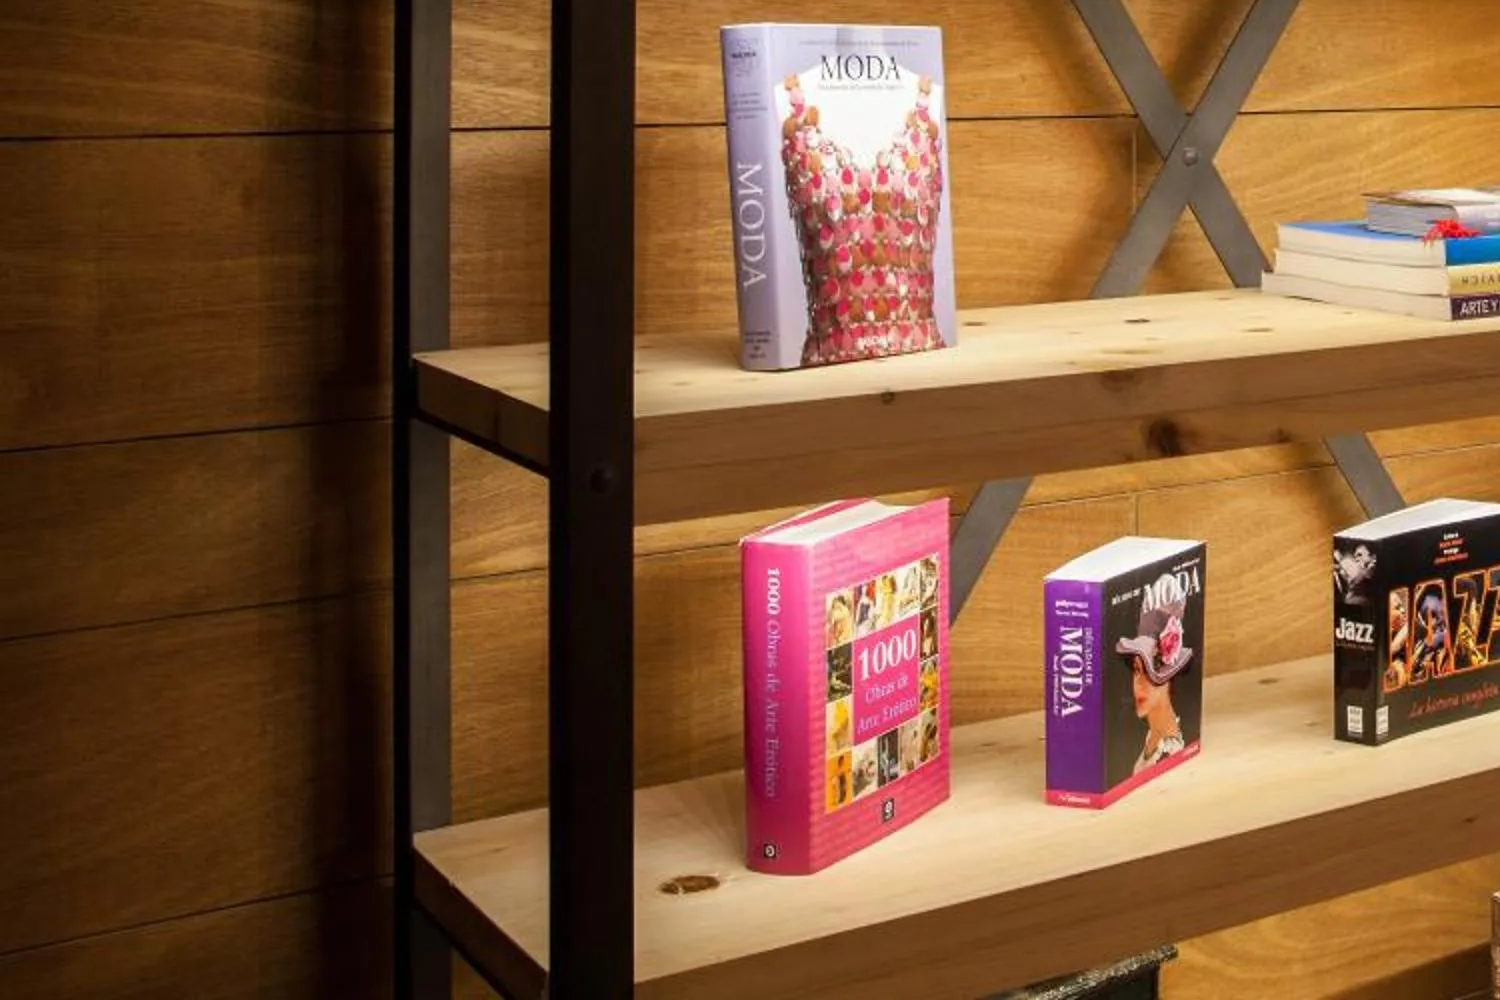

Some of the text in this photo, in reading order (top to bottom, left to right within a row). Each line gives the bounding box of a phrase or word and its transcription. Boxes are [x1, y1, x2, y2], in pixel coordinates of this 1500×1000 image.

[820, 54, 901, 81] MODA
[736, 162, 767, 289] MODA
[1460, 299, 1489, 316] ARTE
[1491, 298, 1499, 312] Y
[767, 567, 781, 615] 1000
[1142, 566, 1201, 613] MODA
[767, 620, 781, 669] Obras
[1335, 617, 1375, 644] Jazz
[858, 629, 917, 680] 1000
[1060, 626, 1084, 718] MODA
[767, 673, 781, 693] de
[765, 699, 780, 732] Arte
